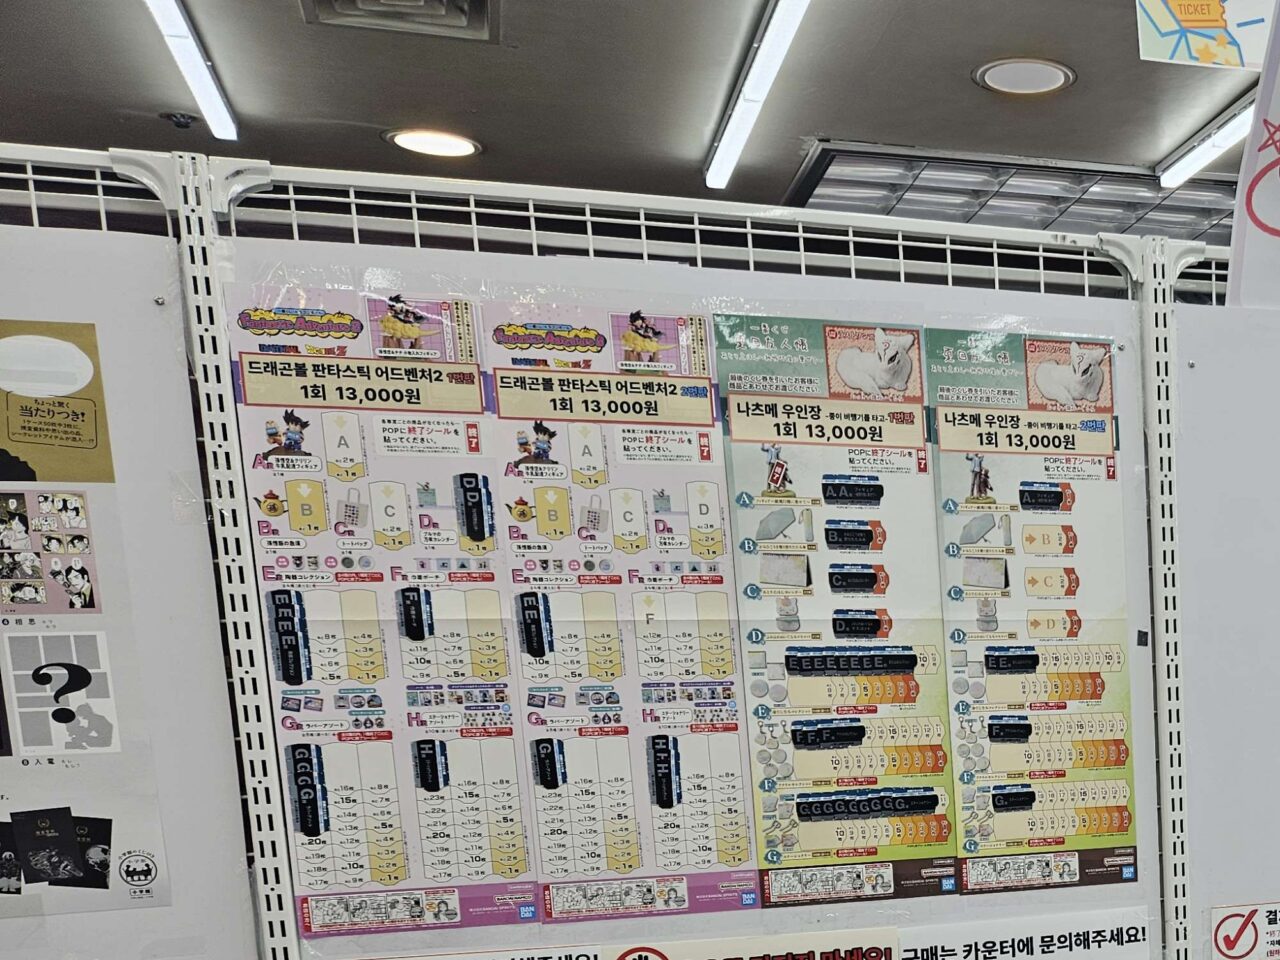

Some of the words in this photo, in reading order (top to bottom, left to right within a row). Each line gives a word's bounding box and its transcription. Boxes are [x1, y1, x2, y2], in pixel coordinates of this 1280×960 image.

[1178, 4, 1211, 15] TICKET
[248, 361, 308, 378] 드래곤볼
[312, 364, 371, 380] 판타스틱
[375, 367, 443, 383] 어드벤처2
[446, 373, 475, 385] 1번판
[300, 384, 327, 401] 1회
[335, 386, 421, 405] 13,000원
[500, 377, 554, 392] 드래곤볼
[558, 379, 612, 394] 판타스틱
[616, 381, 676, 396] 어드벤처2
[681, 386, 708, 398] 2번판
[19, 405, 85, 422] 当たりつき!
[550, 398, 573, 413] 1회
[582, 400, 658, 416] 13,000원
[737, 402, 778, 418] 나츠메
[781, 404, 822, 420] 우인장
[944, 412, 980, 427] 나츠메
[984, 414, 1020, 429] 우인장
[382, 427, 459, 437] POPに終了シールを
[384, 435, 437, 445] 貼ってください。
[774, 422, 798, 438] 1회
[806, 425, 883, 442] 13,000원
[976, 432, 998, 447] 1회
[1006, 433, 1076, 450] 13,000원
[1039, 927, 1146, 954] 문의해주세요!
